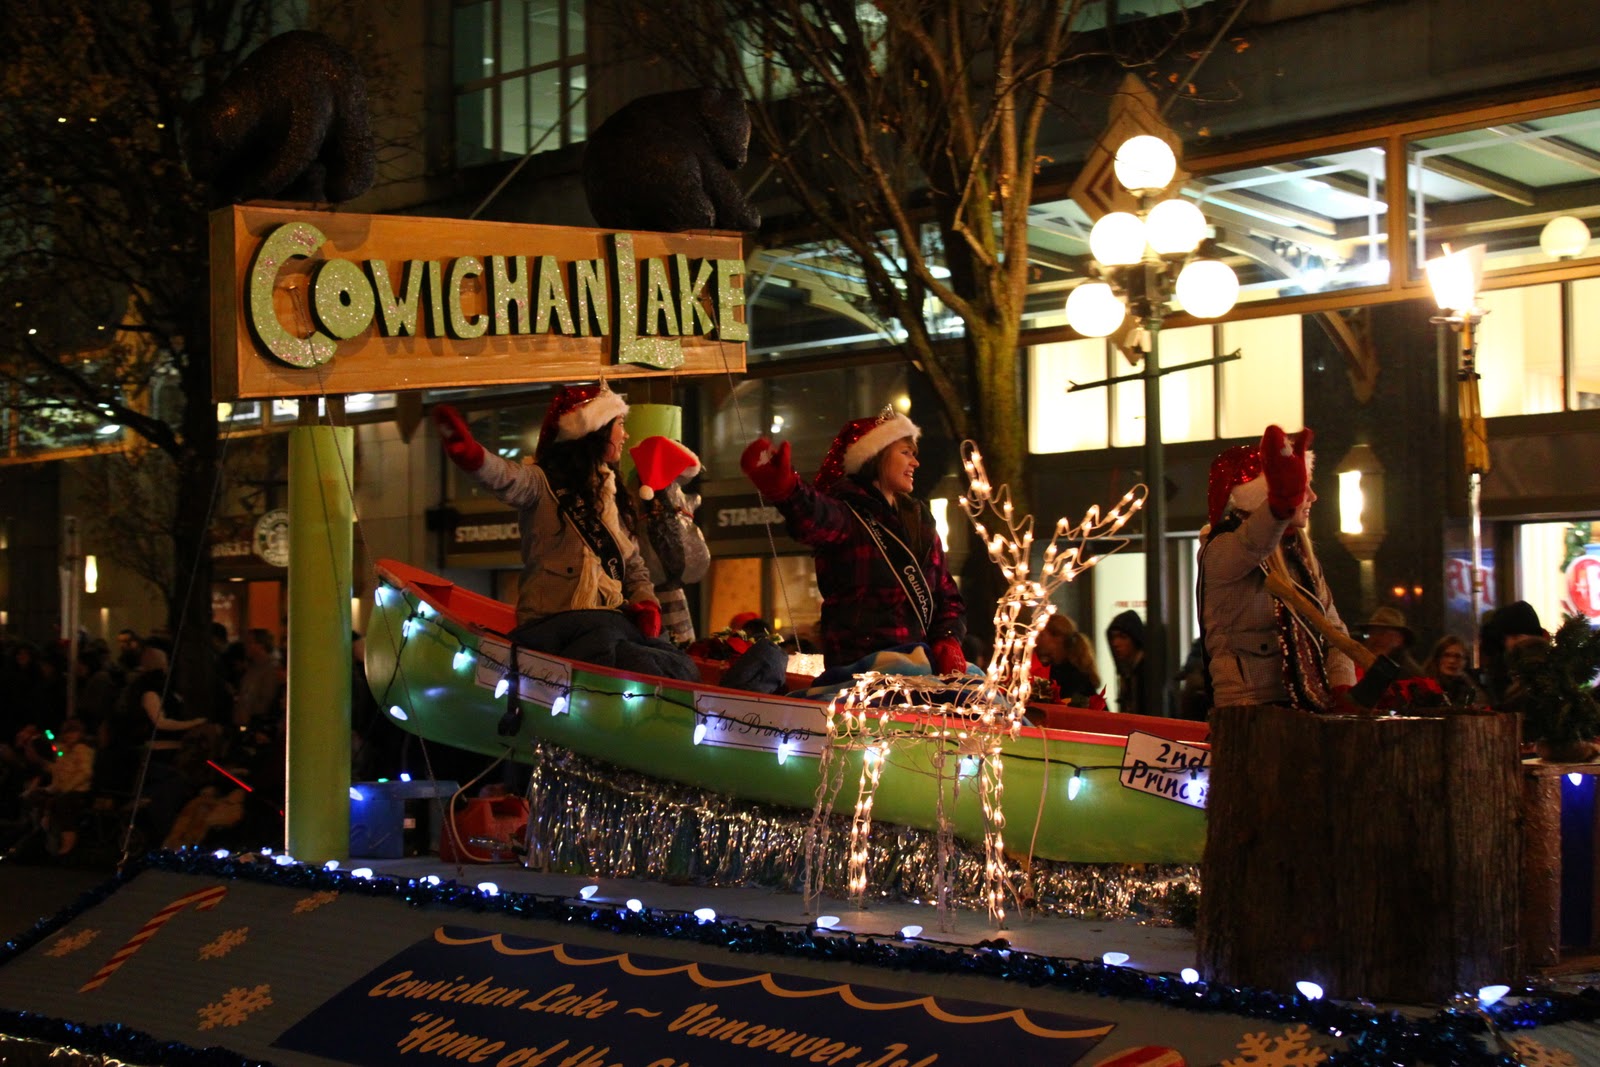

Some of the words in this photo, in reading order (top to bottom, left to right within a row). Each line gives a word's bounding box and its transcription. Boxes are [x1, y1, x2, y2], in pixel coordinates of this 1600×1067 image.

[246, 222, 610, 369] COWICHAN
[611, 233, 749, 369] LAKE
[454, 522, 521, 543] STARBUC
[1156, 743, 1208, 772] 2nd
[1127, 759, 1205, 803] Princ
[368, 970, 530, 1007] Cowichan
[519, 983, 619, 1019] Lake
[668, 1003, 863, 1066] Vancouver
[496, 1039, 570, 1067] of
